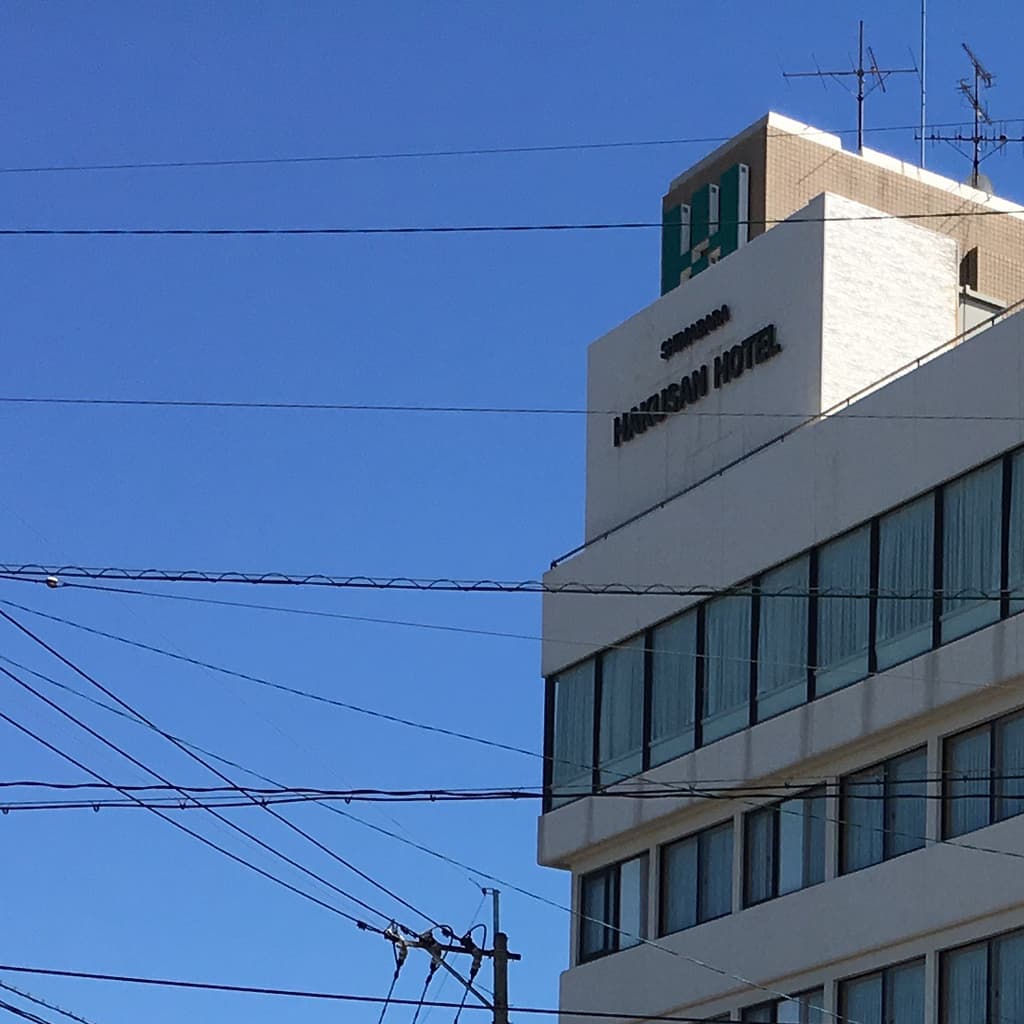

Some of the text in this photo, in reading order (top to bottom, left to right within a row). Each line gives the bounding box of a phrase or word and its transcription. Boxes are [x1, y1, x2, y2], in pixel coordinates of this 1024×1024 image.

[660, 304, 730, 360] SHIMABARA
[613, 323, 782, 448] HAKUSAN HOTEL
